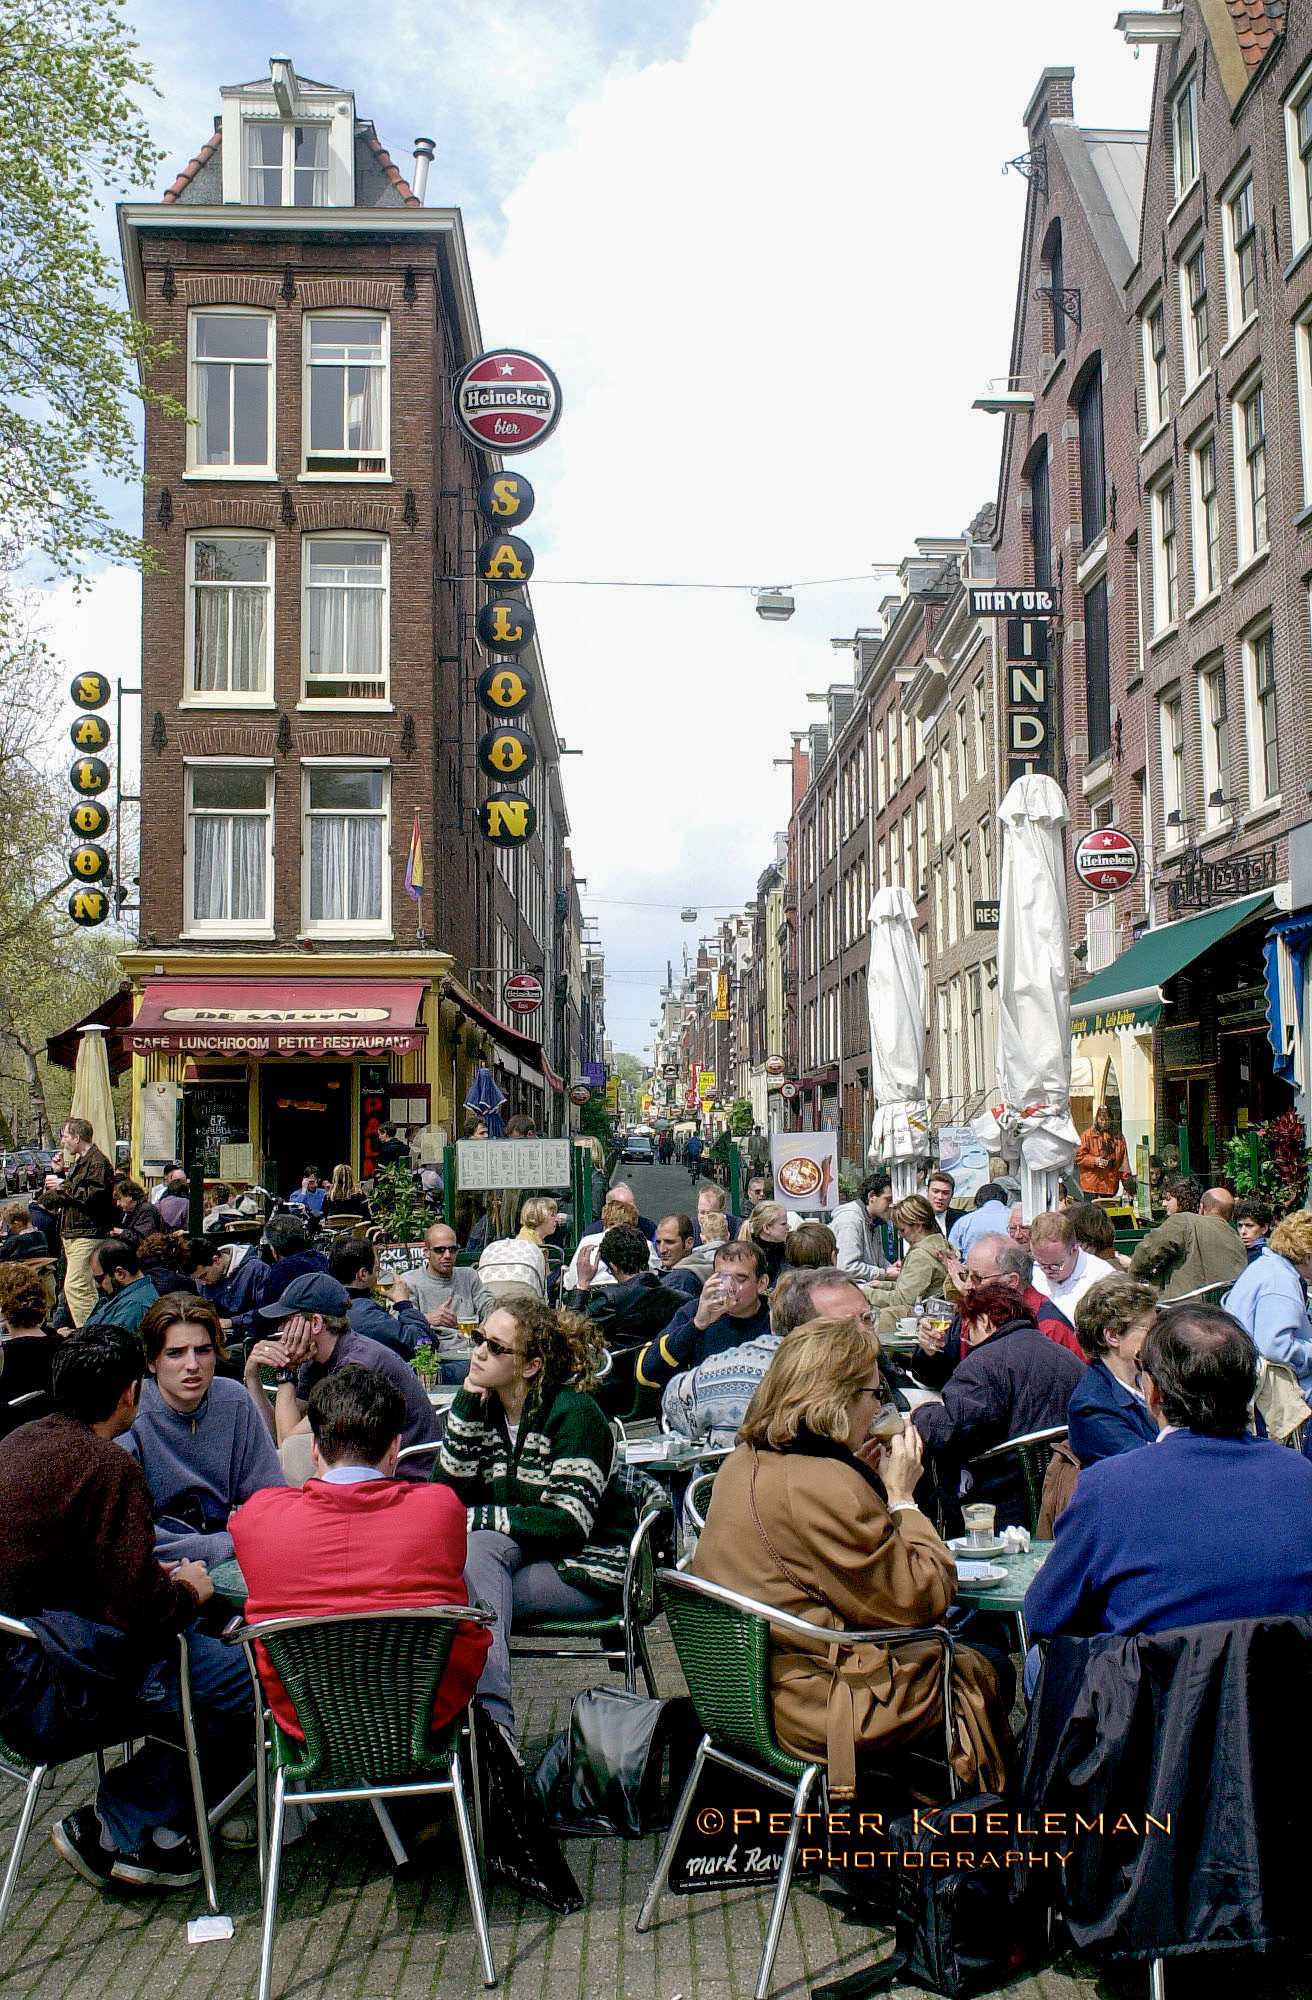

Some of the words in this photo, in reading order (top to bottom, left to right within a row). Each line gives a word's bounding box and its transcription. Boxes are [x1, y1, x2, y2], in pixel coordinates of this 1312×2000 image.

[467, 388, 548, 407] Heineken
[494, 417, 520, 435] bier
[974, 591, 1053, 611] MAYUR
[486, 479, 529, 837] SALOON
[75, 676, 104, 920] SALOON
[1082, 854, 1134, 868] Heineken
[976, 908, 1000, 924] RES
[132, 1036, 169, 1049] CAFÉ
[179, 1037, 270, 1050] LUNCHROOM
[278, 1036, 412, 1050] PETIT-RESTAURANT
